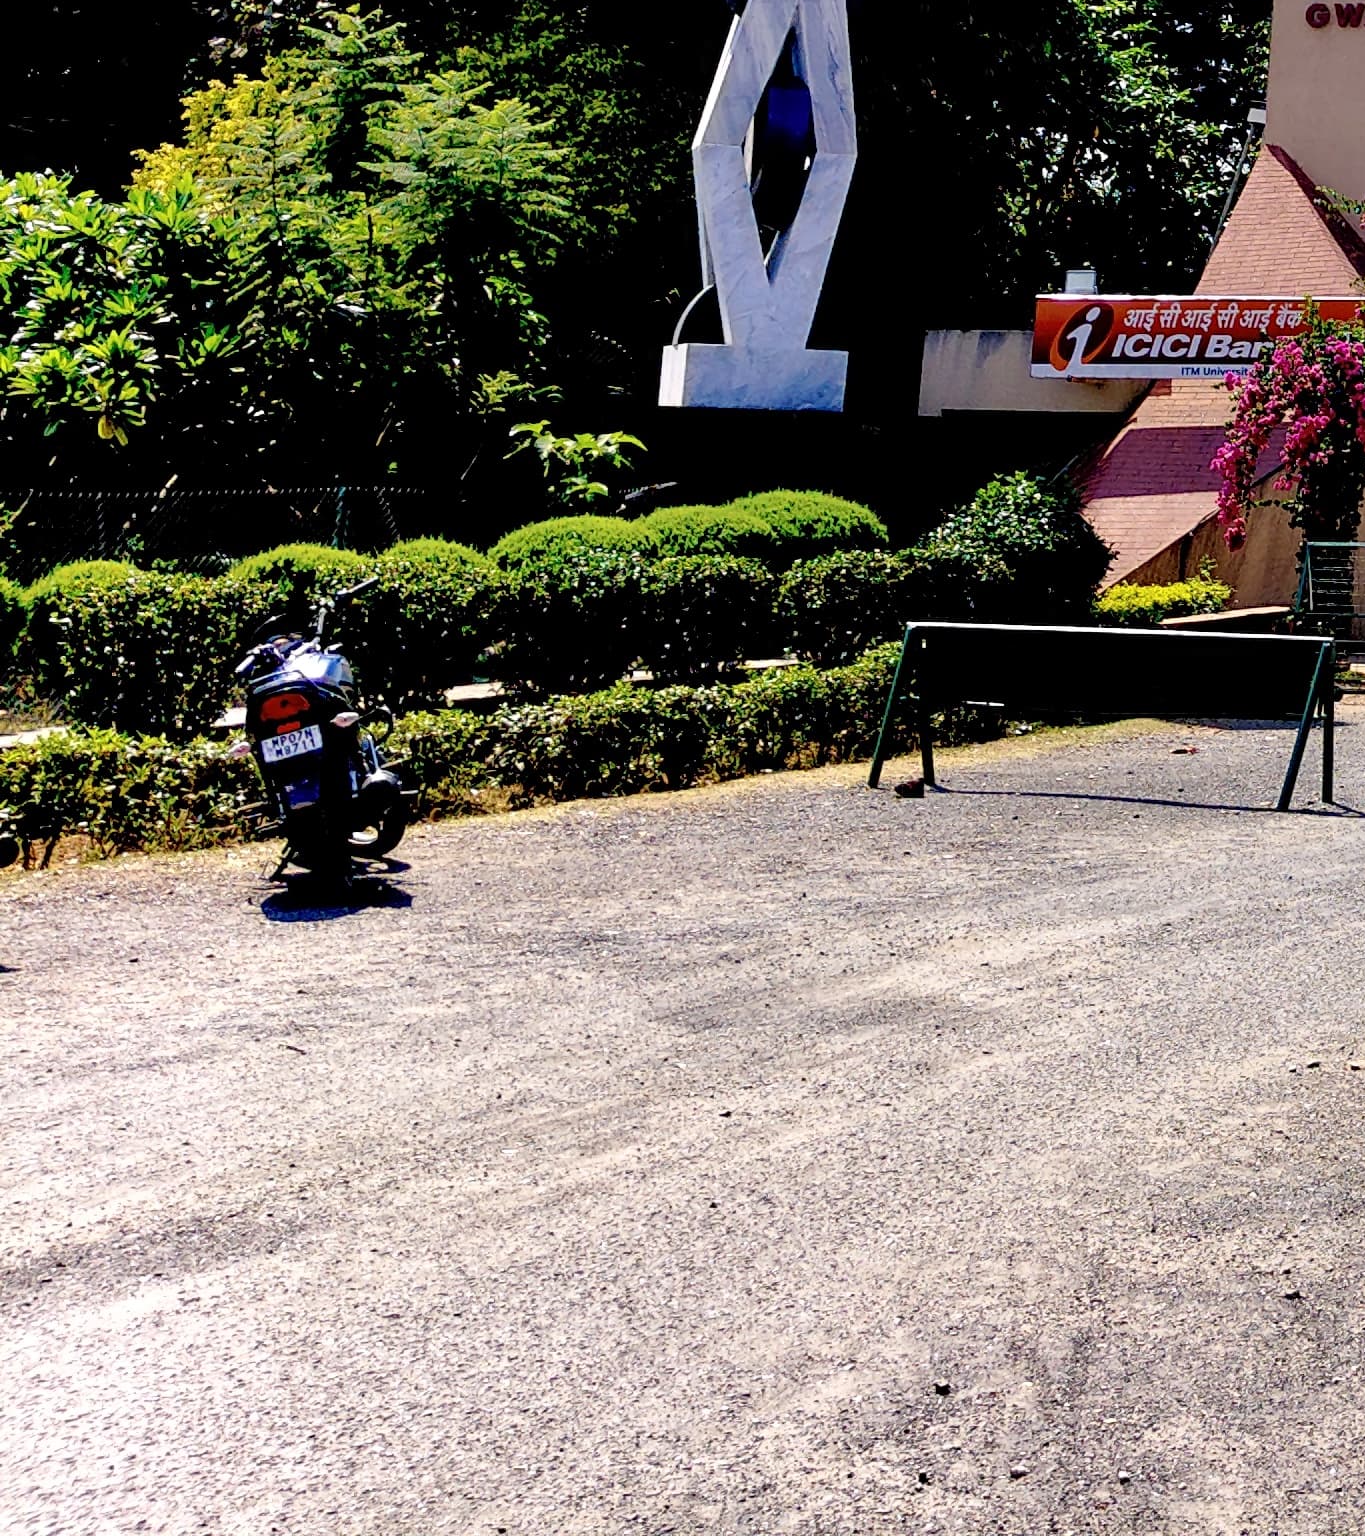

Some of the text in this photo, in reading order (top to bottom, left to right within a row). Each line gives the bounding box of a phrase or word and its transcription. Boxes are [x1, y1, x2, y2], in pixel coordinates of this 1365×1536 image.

[1124, 303, 1159, 332] आई
[1159, 302, 1182, 329] सी
[1181, 303, 1217, 332] आई
[1217, 302, 1239, 329] सी
[1239, 303, 1275, 329] आई
[1111, 333, 1203, 358] ICICI
[1181, 367, 1200, 375] ITM
